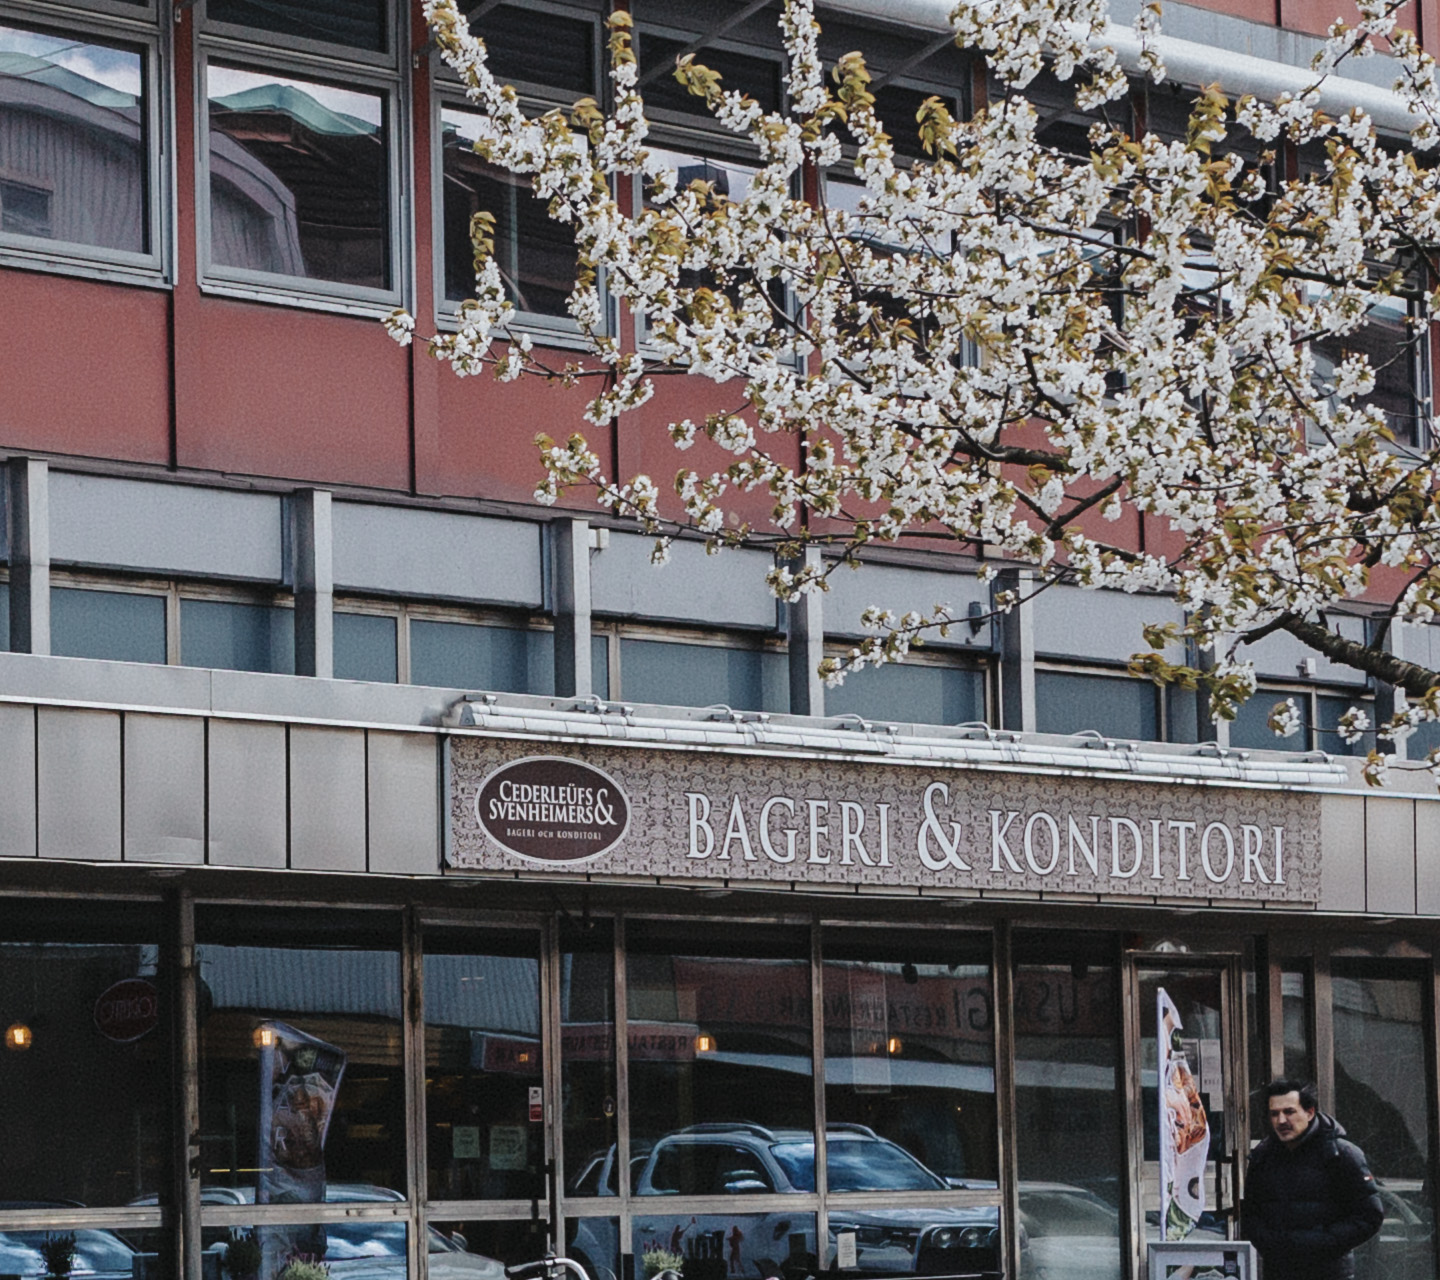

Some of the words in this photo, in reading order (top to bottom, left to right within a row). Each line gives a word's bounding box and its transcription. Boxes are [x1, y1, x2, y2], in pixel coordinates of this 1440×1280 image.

[489, 798, 594, 825] SVENHEIMERS
[506, 827, 535, 838] BAGERI
[556, 829, 602, 841] KONDITORI
[684, 790, 894, 869] BAGERI
[916, 781, 972, 872] &
[988, 807, 1287, 886] KONDITORI
